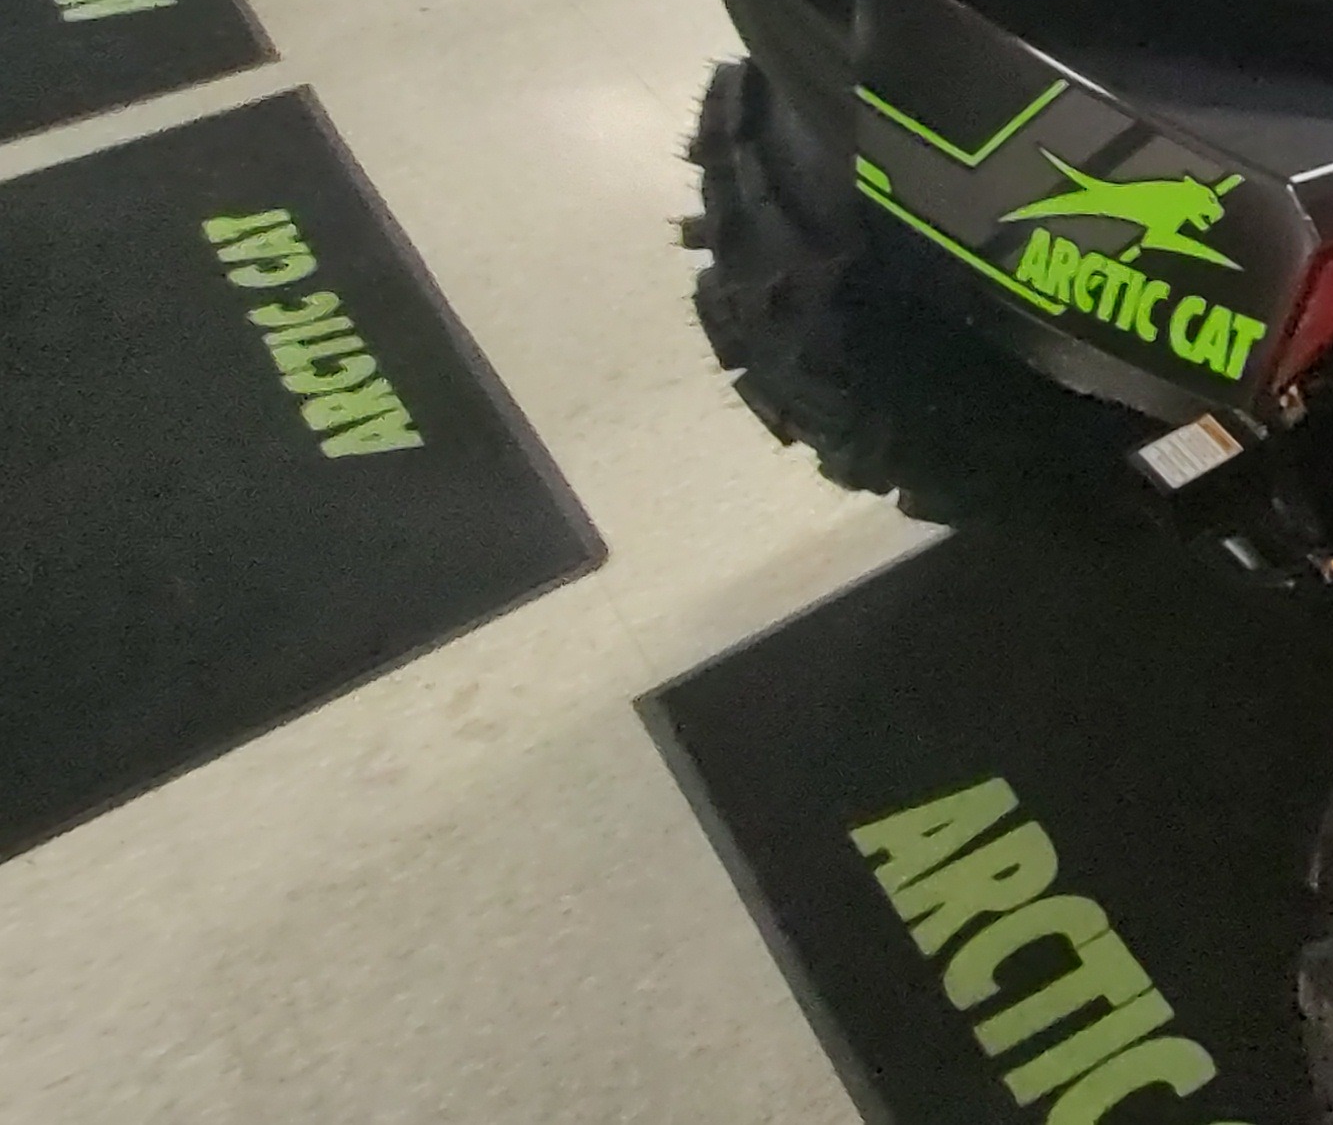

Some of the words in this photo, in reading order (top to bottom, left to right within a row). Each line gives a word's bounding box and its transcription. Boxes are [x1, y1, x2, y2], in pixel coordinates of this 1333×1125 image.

[202, 208, 318, 288] CAT
[1016, 227, 1171, 343] ARCTIC
[1169, 294, 1266, 380] CAT
[247, 290, 425, 459] ARCTIC
[848, 777, 1218, 1125] ARCTIC
